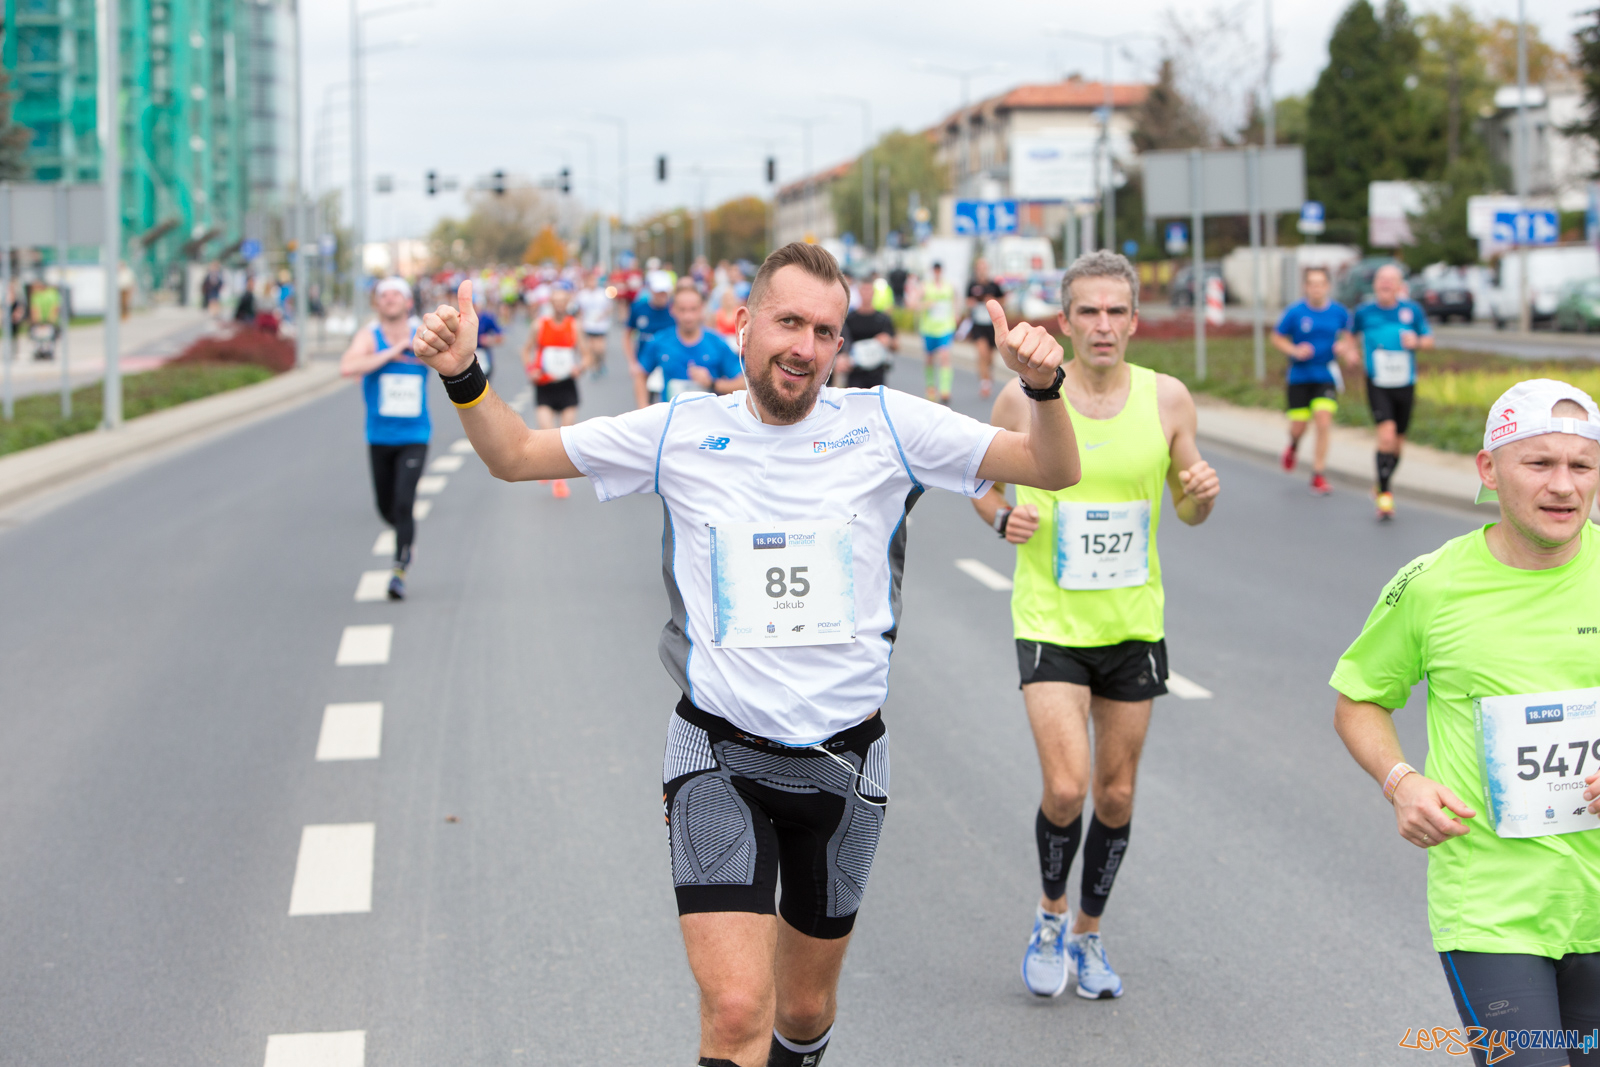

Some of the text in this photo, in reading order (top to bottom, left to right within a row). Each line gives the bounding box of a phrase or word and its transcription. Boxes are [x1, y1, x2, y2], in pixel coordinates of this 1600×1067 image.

[1492, 423, 1516, 440] ORLEN
[855, 434, 870, 444] 2017
[767, 537, 783, 545] PKO
[1081, 531, 1133, 554] 1527
[766, 566, 810, 598] 85
[773, 600, 805, 610] Jakub
[1528, 711, 1541, 720] 18.
[1541, 708, 1561, 718] PKO
[1567, 709, 1596, 717] maraton
[1572, 806, 1586, 815] 4F
[1044, 832, 1069, 880] Kalenji
[1093, 838, 1127, 896] Kalenji
[1485, 1006, 1519, 1018] Kalenji
